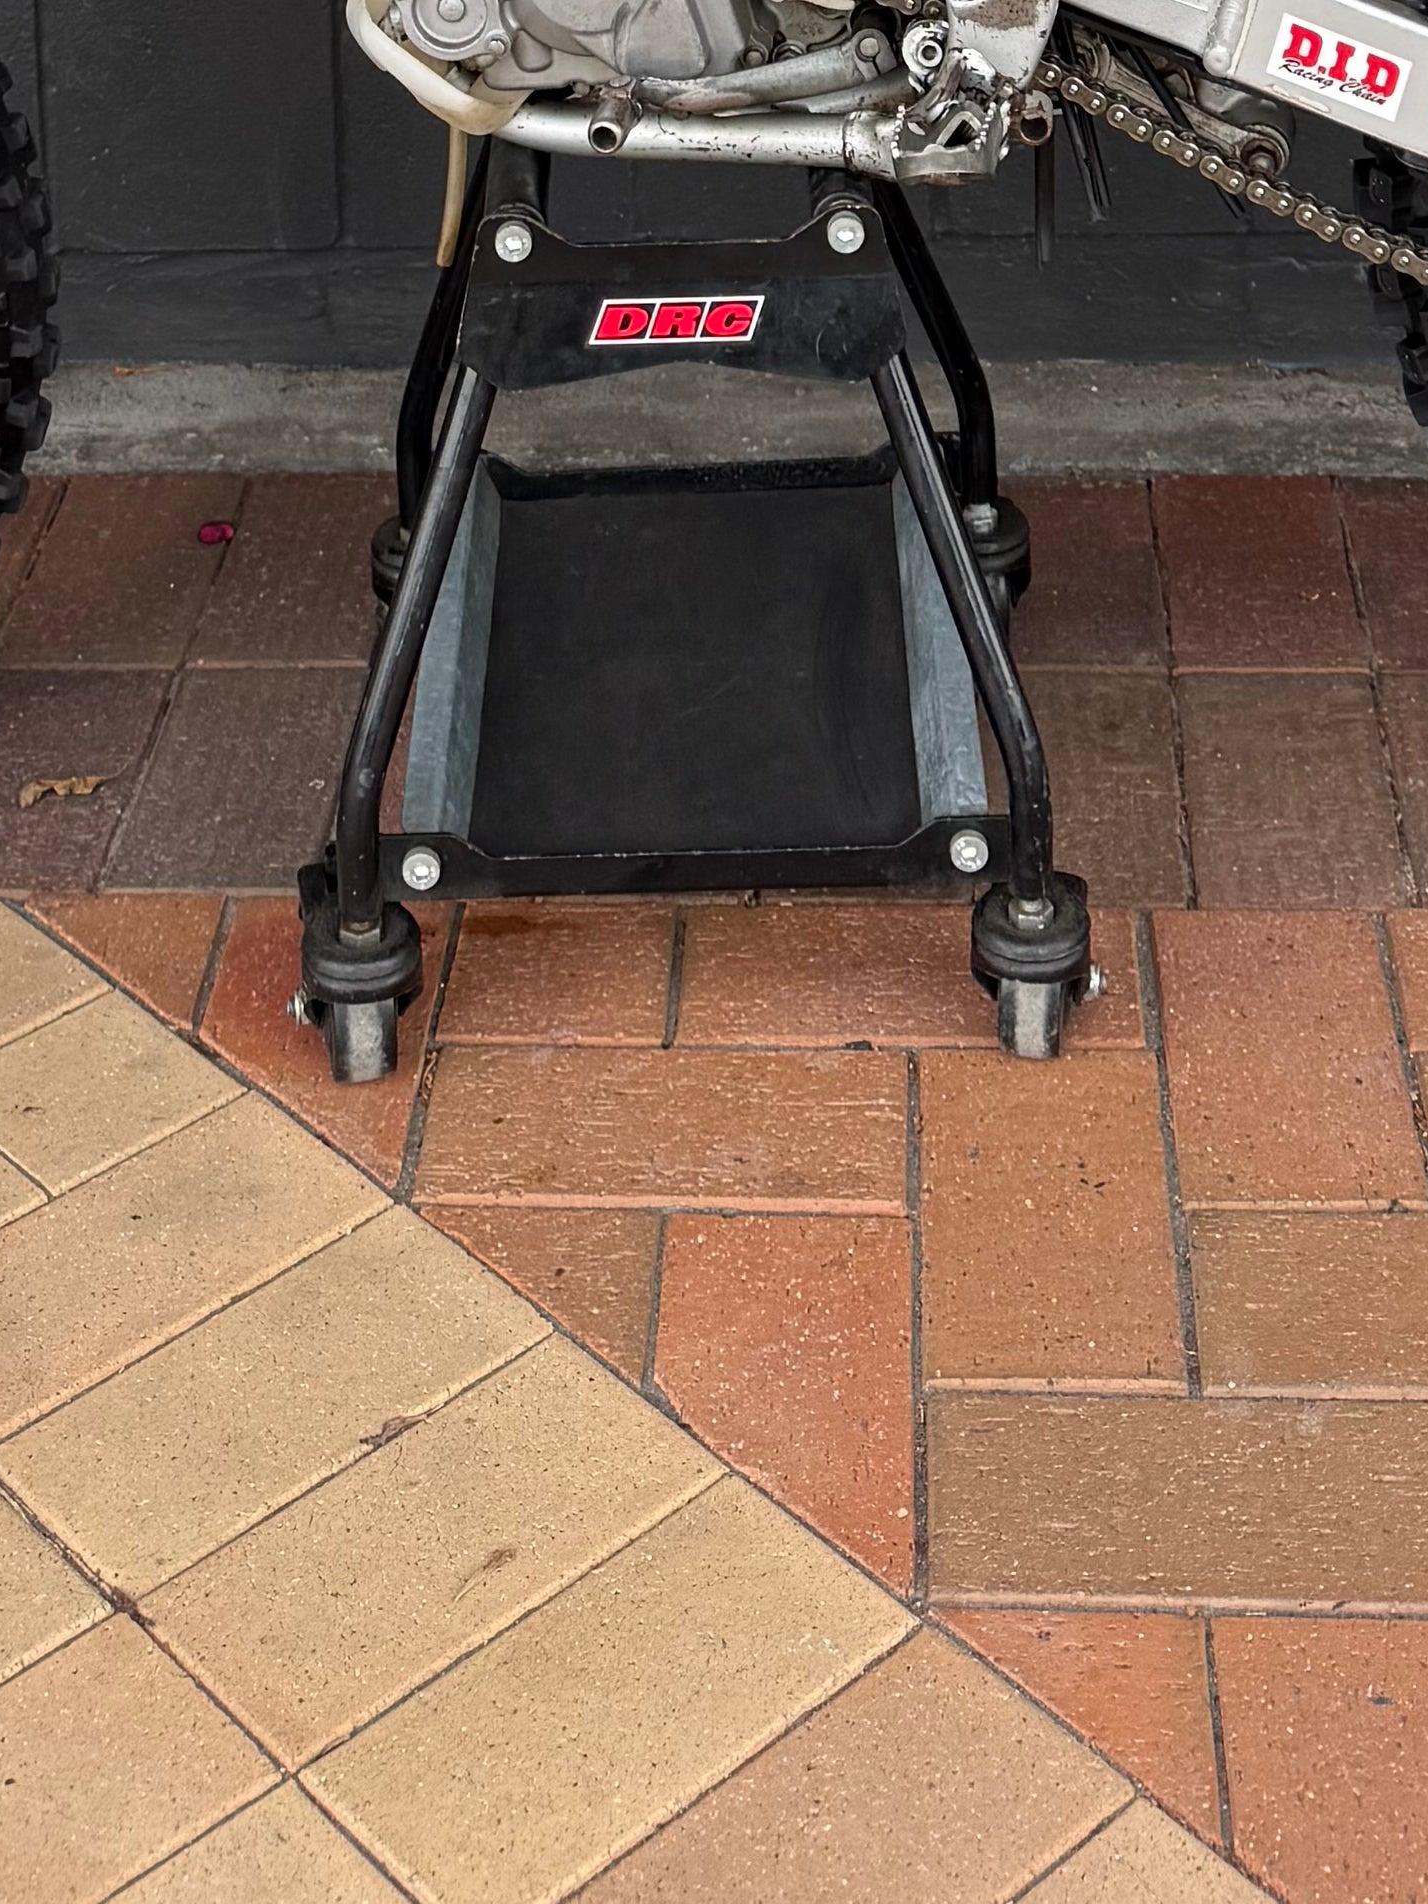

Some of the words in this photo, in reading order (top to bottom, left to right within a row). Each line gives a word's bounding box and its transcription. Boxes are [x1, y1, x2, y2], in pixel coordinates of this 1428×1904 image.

[1278, 58, 1333, 90] Racing
[1339, 78, 1386, 106] Chain
[1283, 23, 1400, 99] D.I.D
[594, 302, 755, 342] DRC
